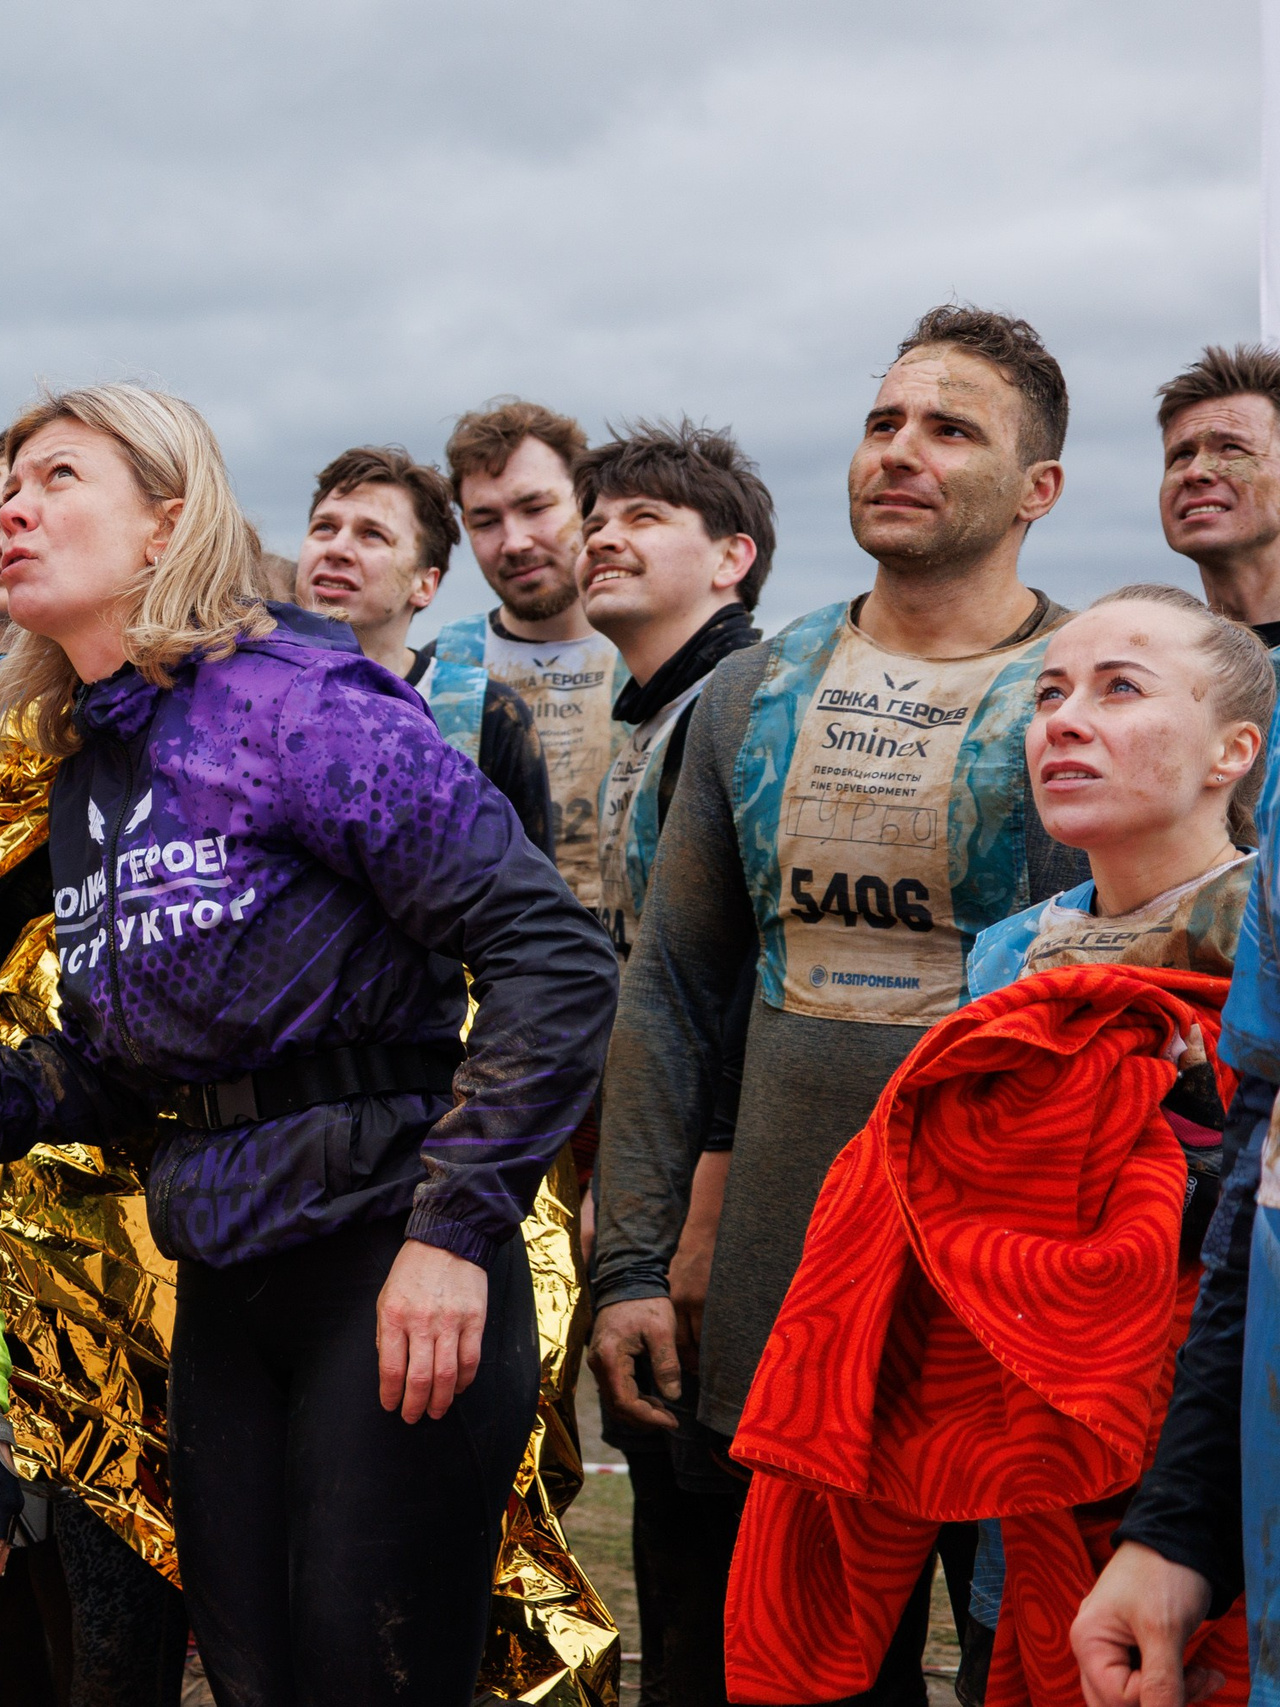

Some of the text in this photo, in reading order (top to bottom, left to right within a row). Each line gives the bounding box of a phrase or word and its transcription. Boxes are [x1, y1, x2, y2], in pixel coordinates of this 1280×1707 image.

[542, 671, 605, 687] ГЕРОЕВ
[531, 697, 584, 719] inex
[818, 689, 969, 724] ГОНКА ГЕРОЕВ
[821, 722, 931, 758] Sminex
[813, 765, 922, 782] ПЕРФЕКЦИОНИСТЫ
[810, 781, 918, 797] FINE DEVELOPMENT
[790, 867, 935, 933] 5406
[59, 887, 256, 975] СТРУКТОР
[831, 971, 920, 990] ГАЗПРОМБАНК
